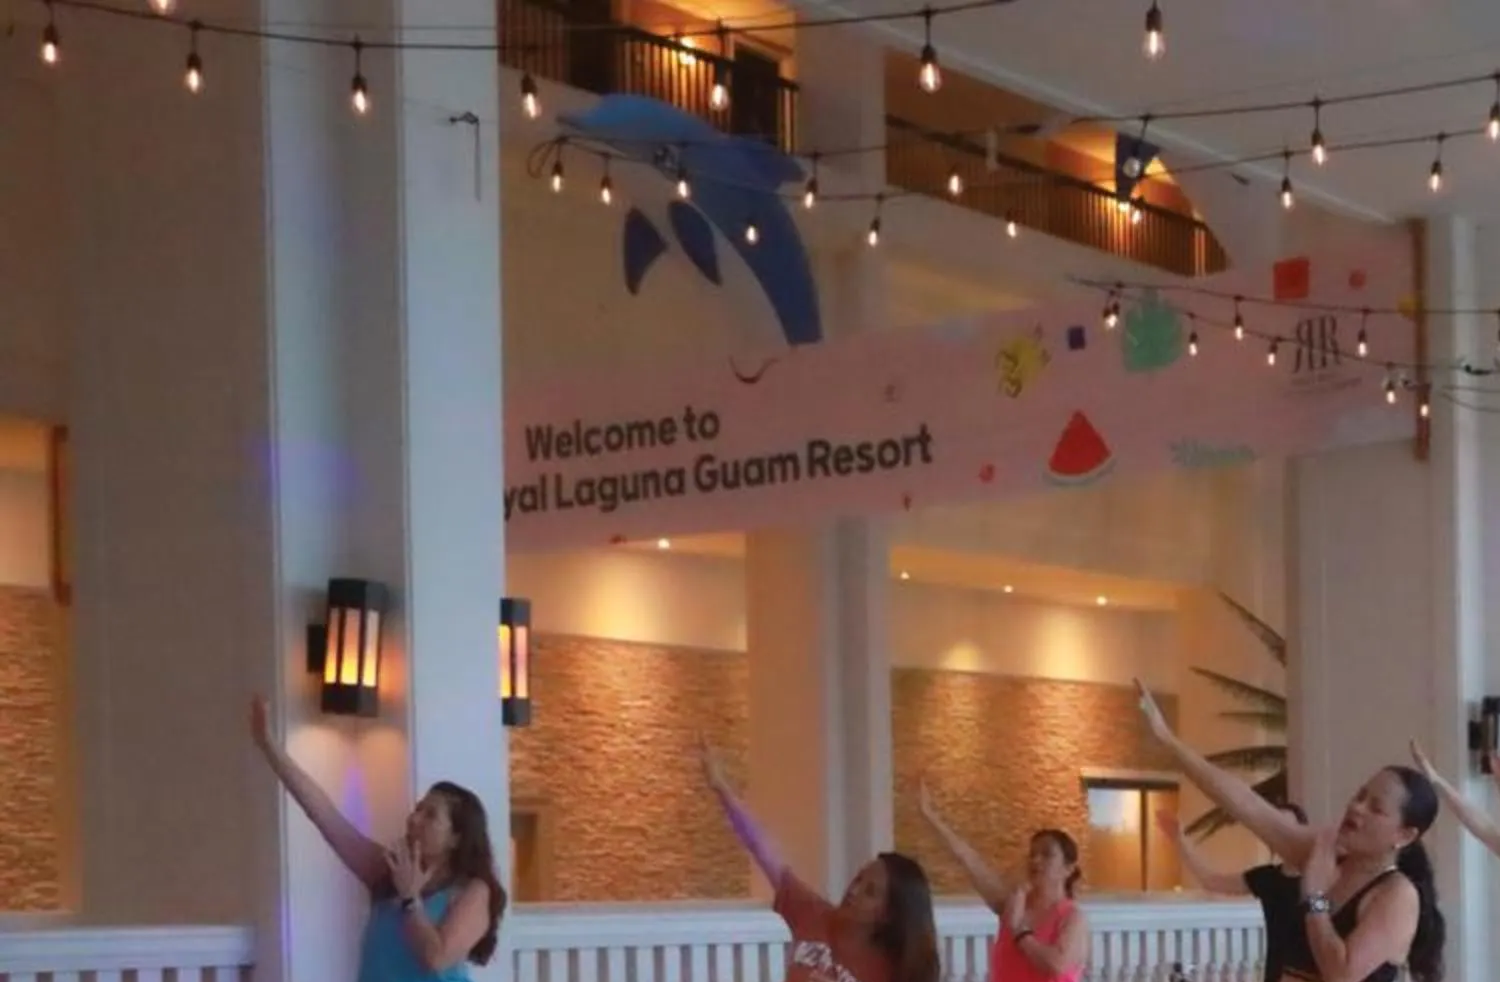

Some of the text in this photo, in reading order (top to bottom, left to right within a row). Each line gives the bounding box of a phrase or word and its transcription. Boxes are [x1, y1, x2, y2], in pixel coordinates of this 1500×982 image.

[525, 406, 720, 462] Welcome to
[554, 466, 686, 513] Laguna
[693, 450, 800, 493] Guam
[806, 424, 934, 479] Resort
